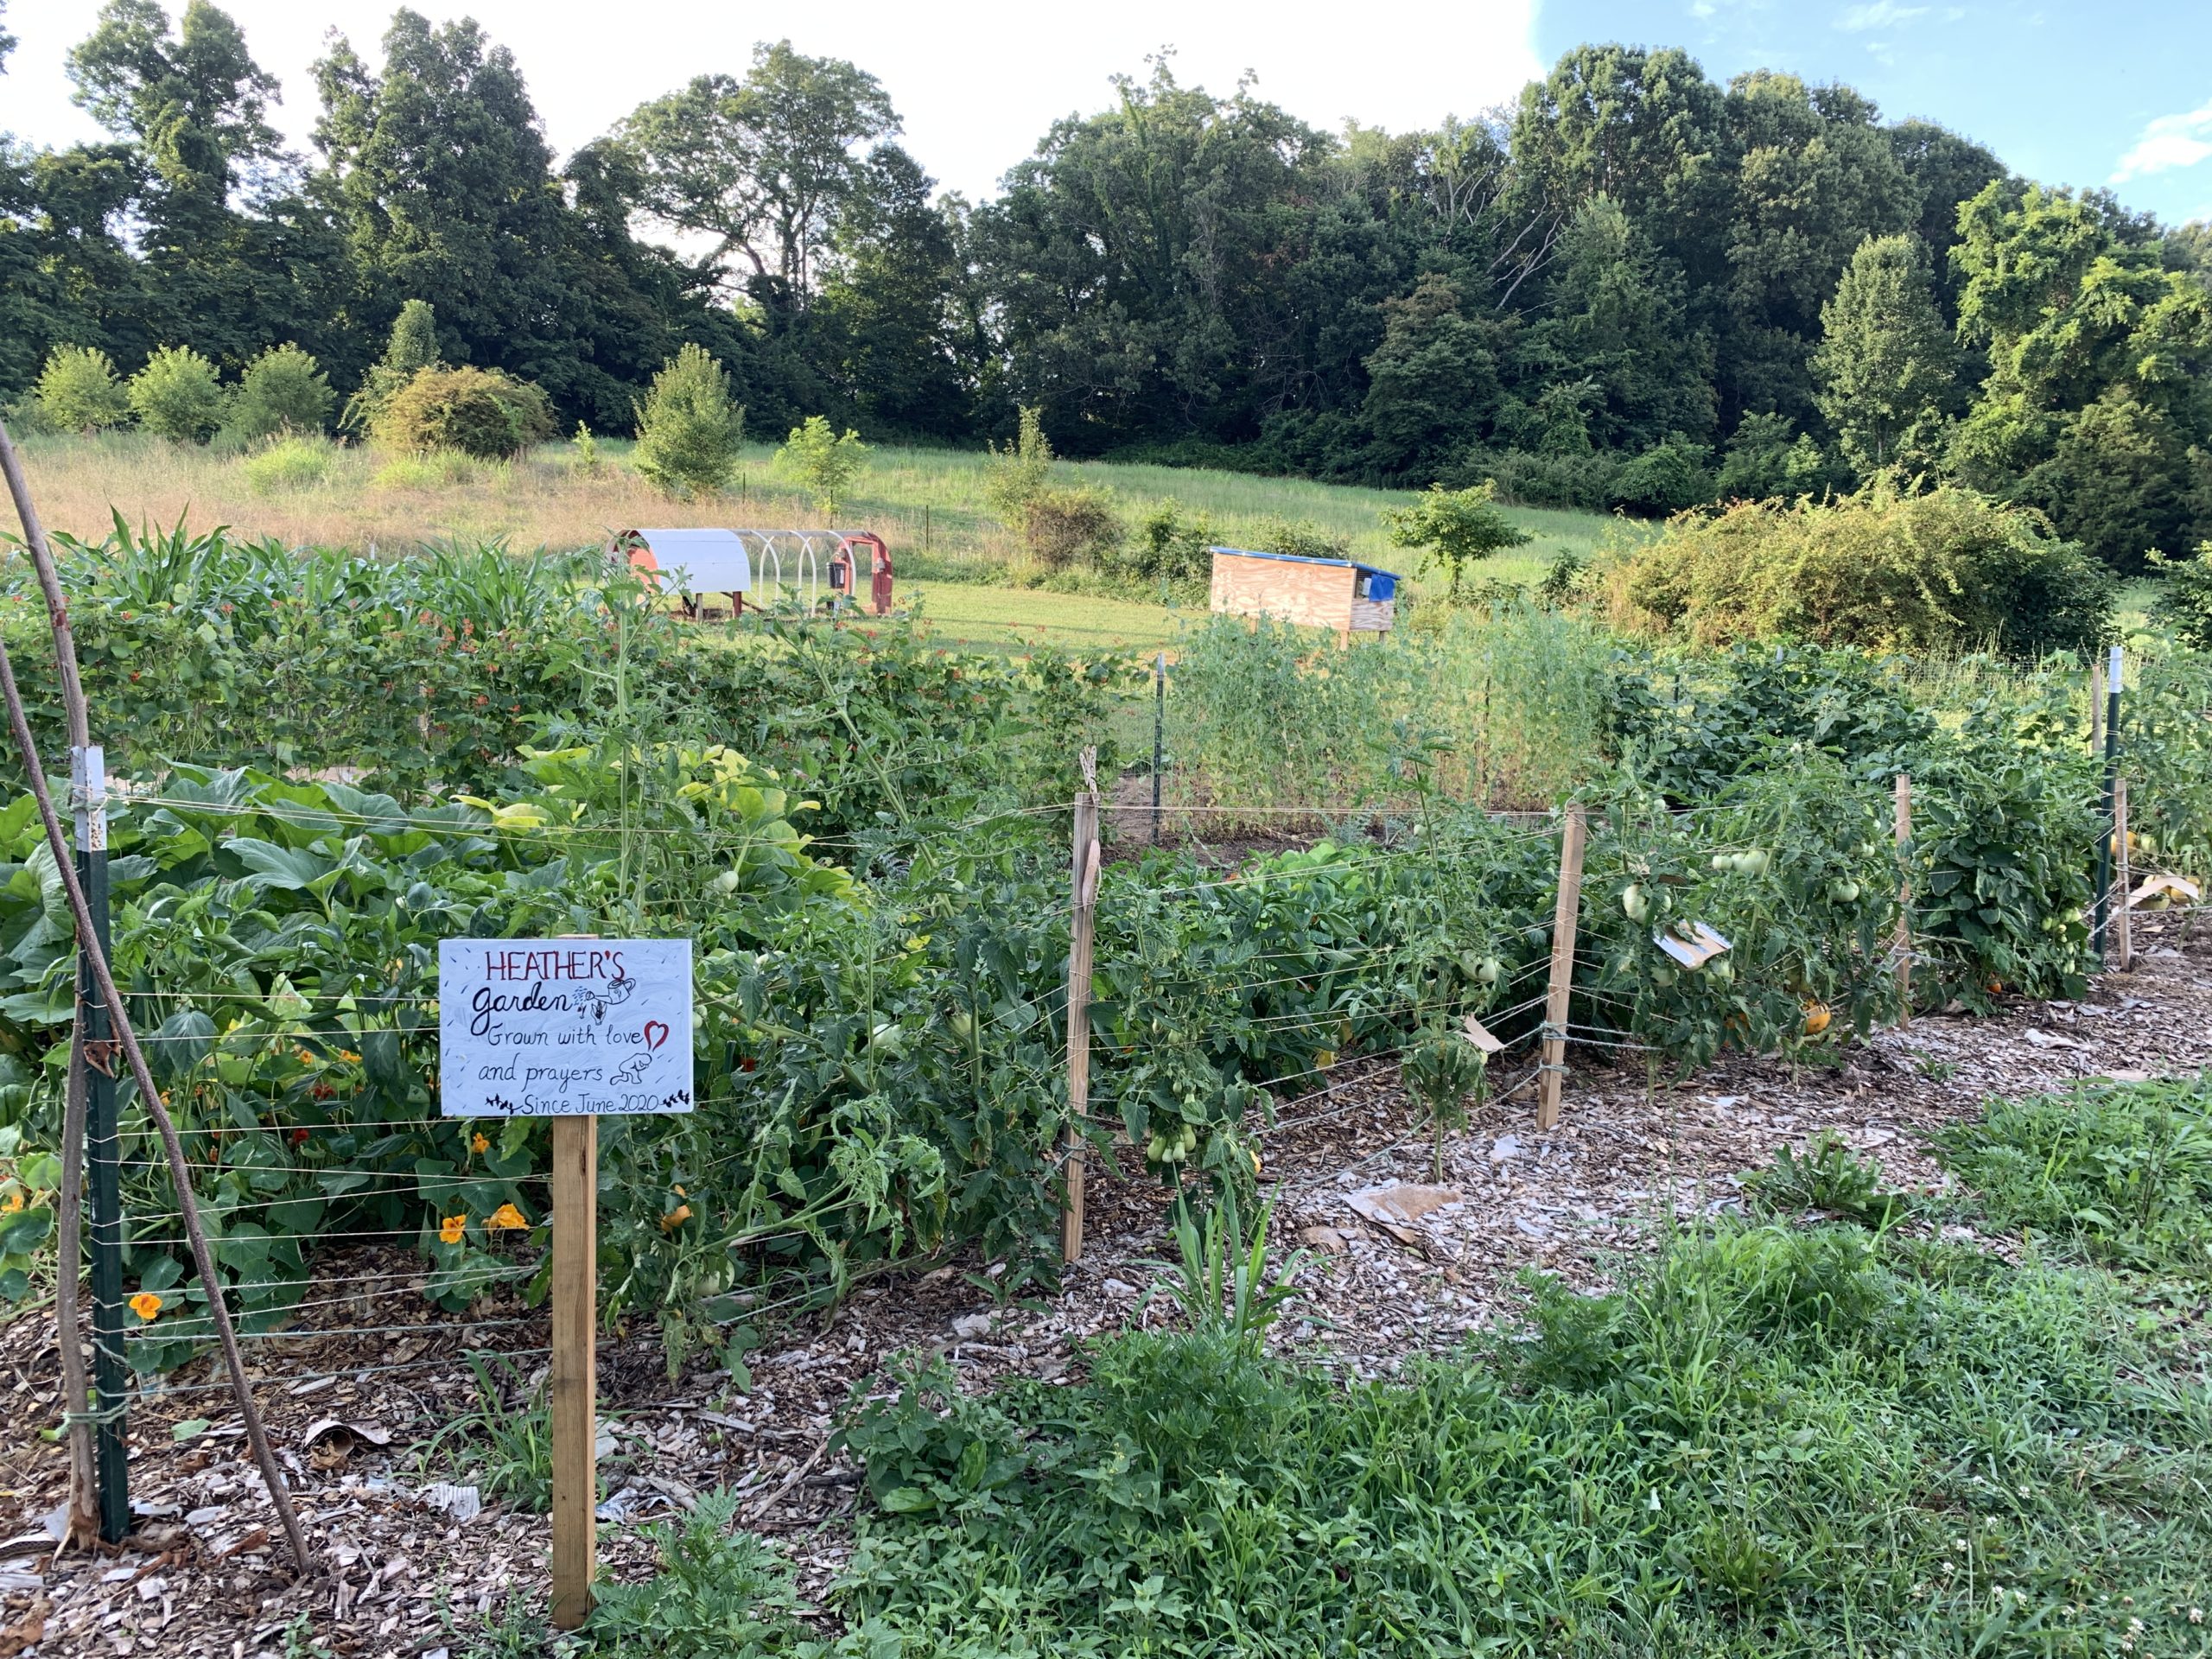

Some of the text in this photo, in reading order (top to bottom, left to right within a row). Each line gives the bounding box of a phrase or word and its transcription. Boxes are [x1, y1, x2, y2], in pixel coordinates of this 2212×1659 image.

[485, 950, 625, 981] HEATHER'S
[470, 982, 573, 1036] garden
[487, 1023, 644, 1046] Grown with love
[478, 1052, 603, 1093] and prayers
[521, 1093, 658, 1115] Since June 2020
